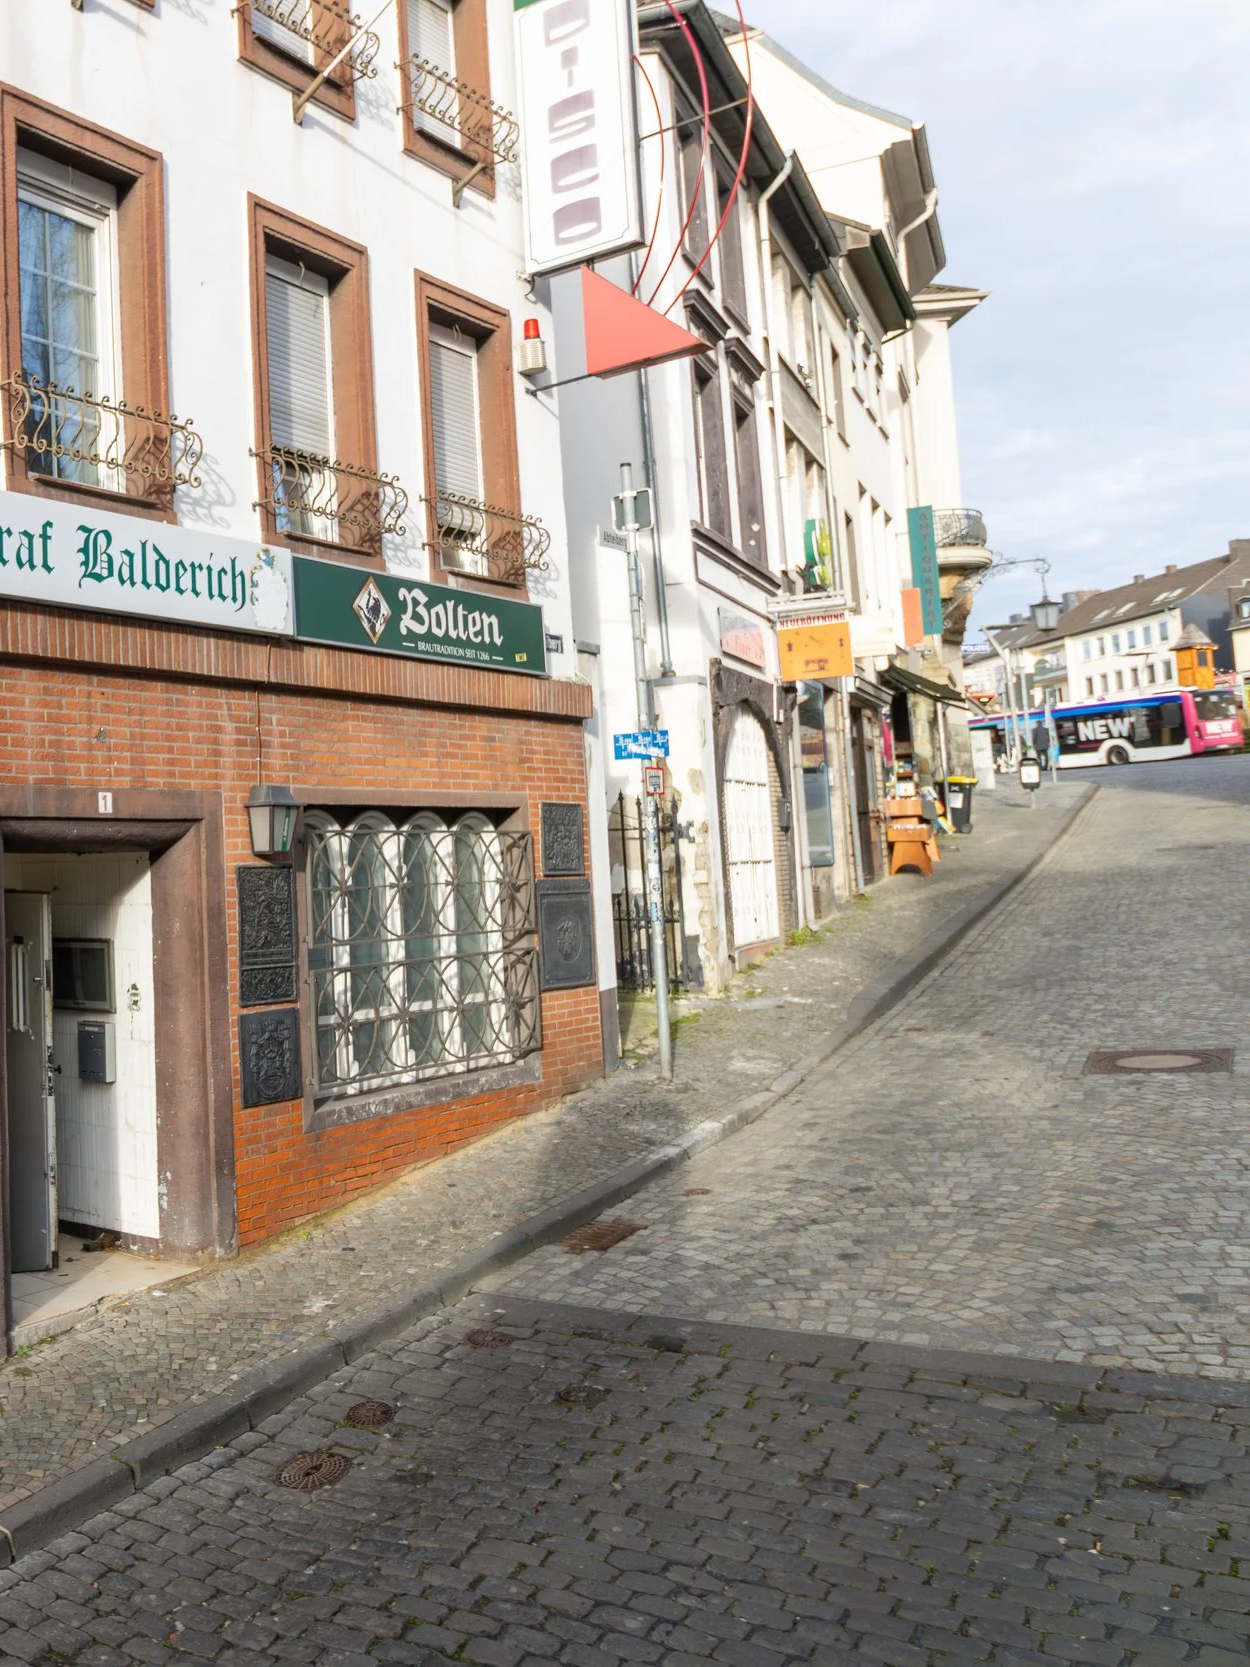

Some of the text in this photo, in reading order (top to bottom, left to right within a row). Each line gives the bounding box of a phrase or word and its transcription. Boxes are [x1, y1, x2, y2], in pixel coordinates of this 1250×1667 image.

[75, 524, 248, 612] Balderich
[918, 512, 938, 629] ANTIQUARIAT
[398, 587, 503, 646] Bolten
[779, 612, 846, 628] NEUERÖFFNUNG
[418, 641, 464, 657] BRAUTRADITION
[465, 648, 476, 659] SEIT
[1077, 717, 1131, 741] NEW
[1205, 720, 1234, 734] NEW
